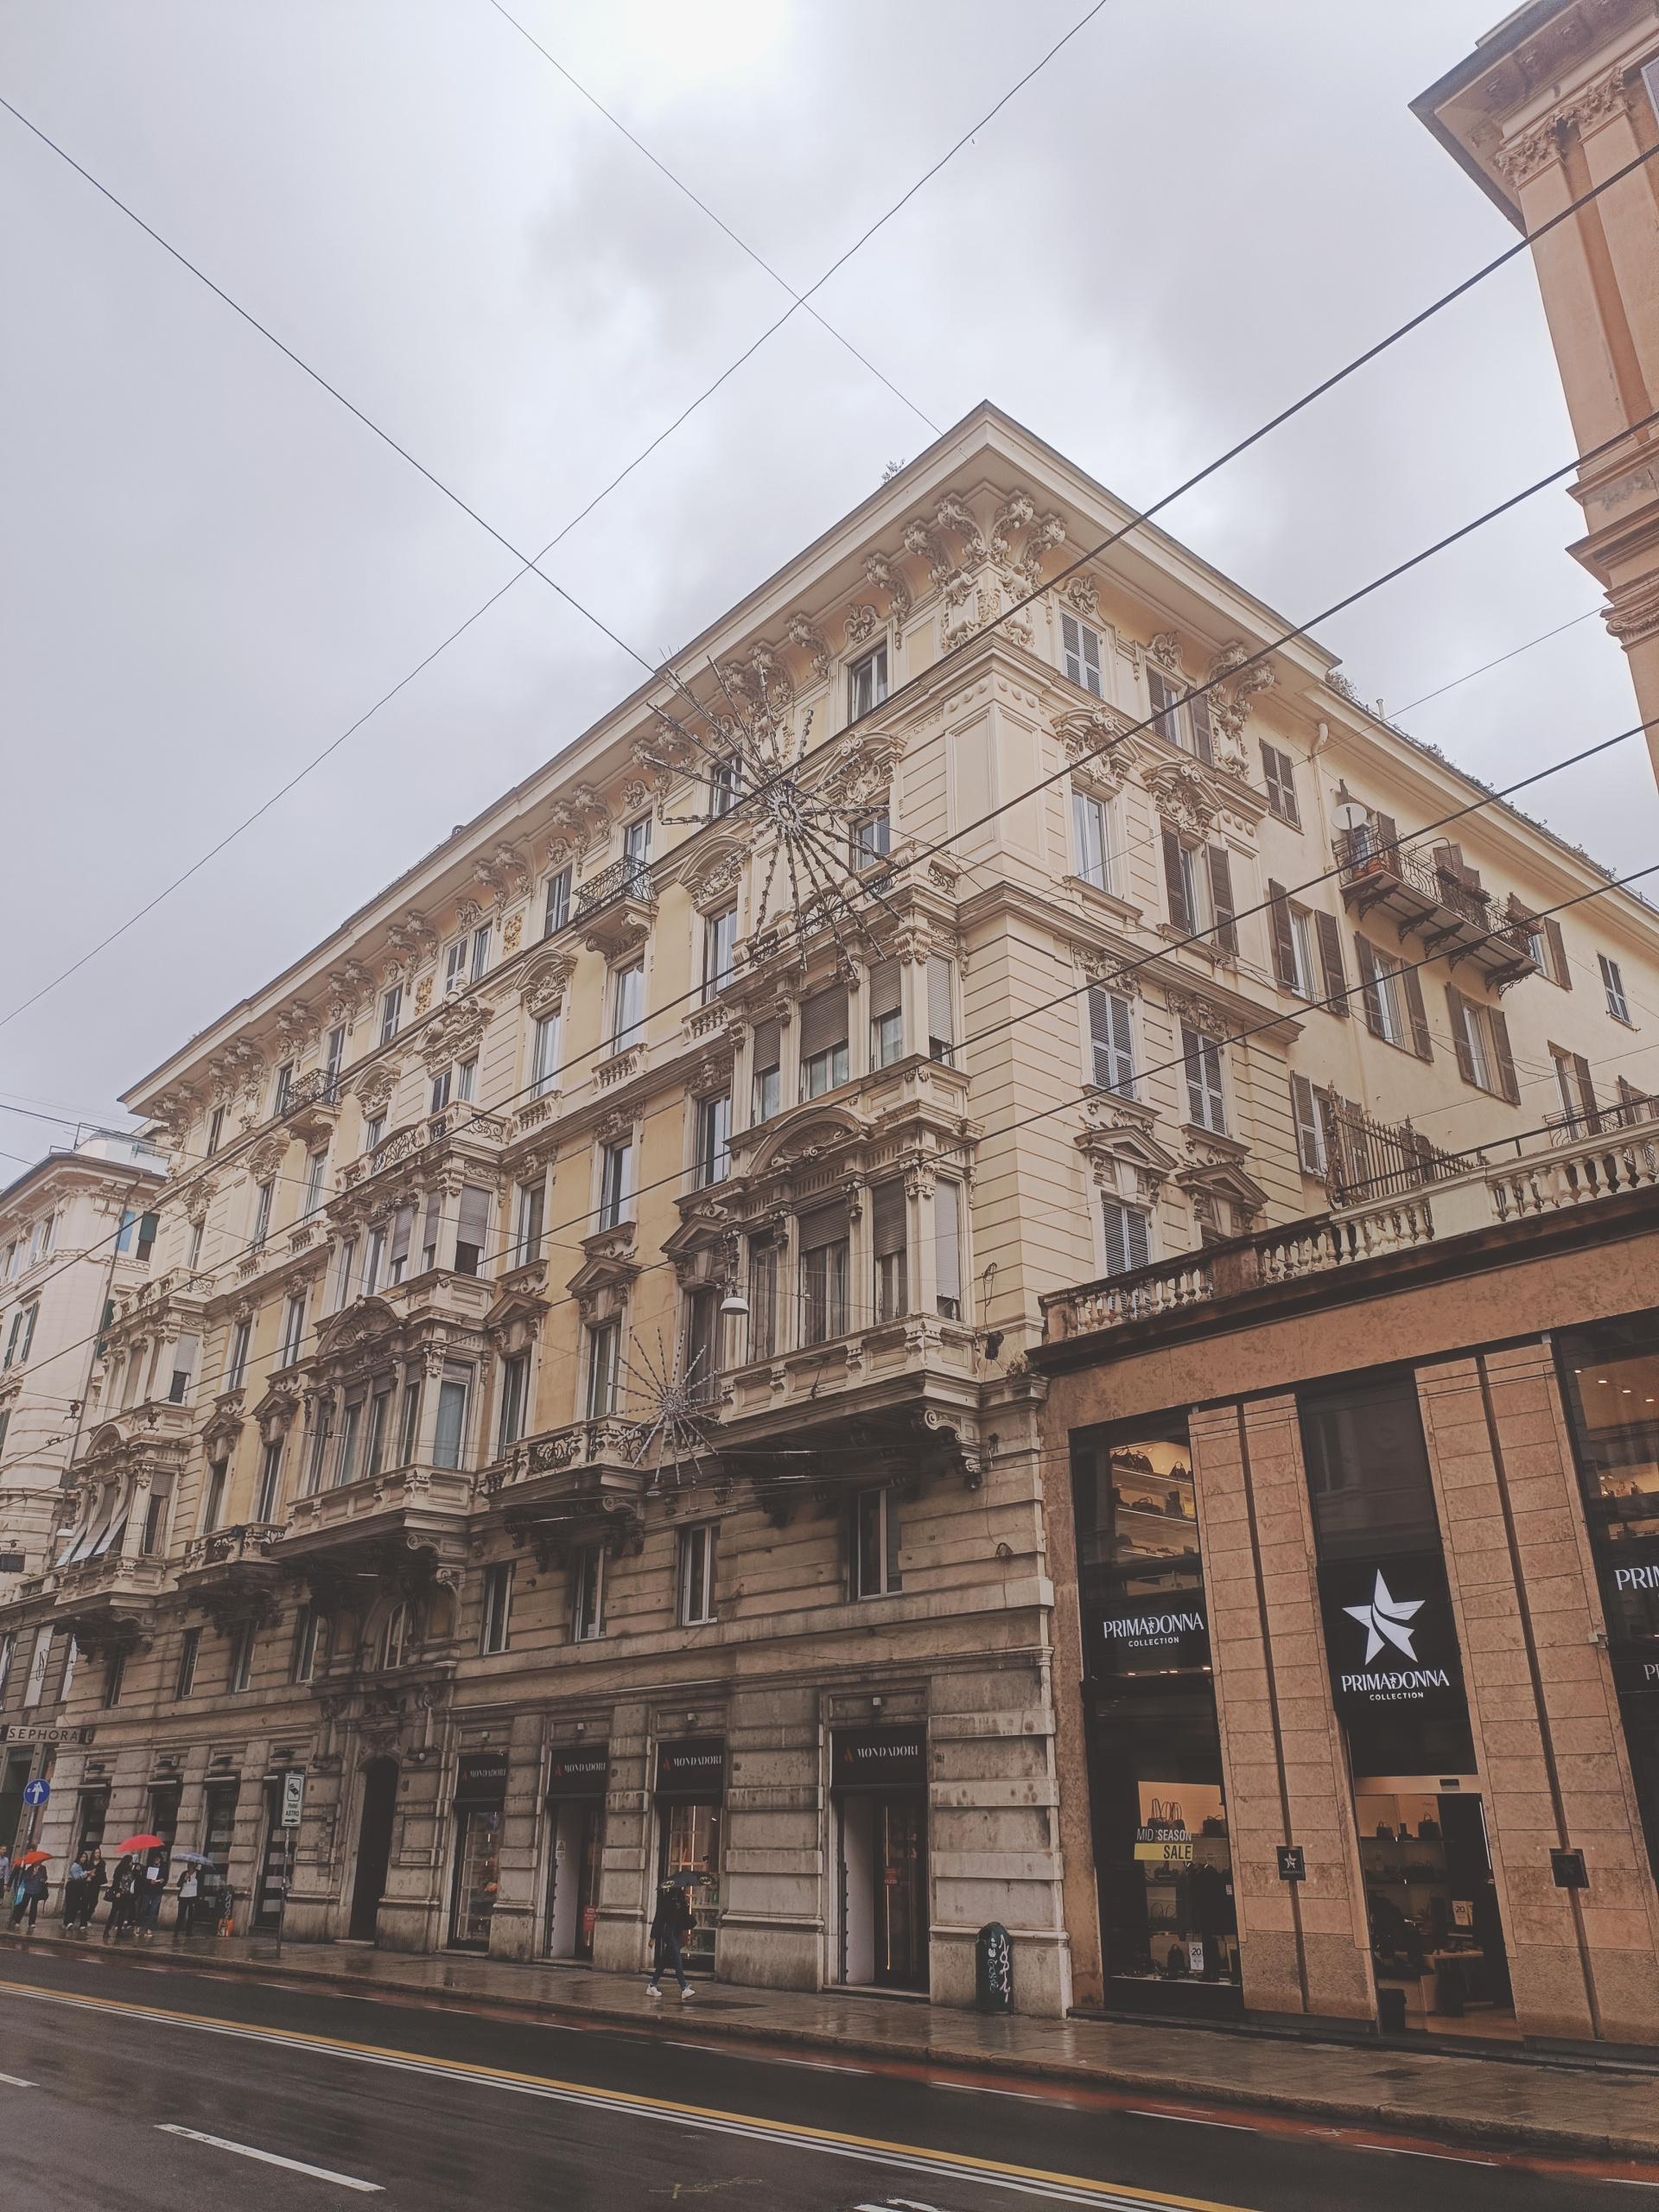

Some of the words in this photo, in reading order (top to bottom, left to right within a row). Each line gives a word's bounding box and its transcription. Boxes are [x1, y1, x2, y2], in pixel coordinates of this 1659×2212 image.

[1613, 1566, 1659, 1591] PRI
[1103, 1611, 1205, 1638] PRIMADONNA
[1128, 1637, 1179, 1648] COLLECTION
[1340, 1669, 1450, 1692] PRIMADONNA
[1370, 1691, 1424, 1700] COLLECTION
[8, 1728, 78, 1741] SEPHORA
[857, 1745, 918, 1758] MONDADORI
[564, 1762, 606, 1773] MONDADORI
[674, 1755, 721, 1767] MONDADORI
[470, 1769, 506, 1778] MONDADORI
[1136, 1828, 1154, 1841] MID
[1157, 1829, 1192, 1841] SEASON
[1163, 1845, 1192, 1859] SALE
